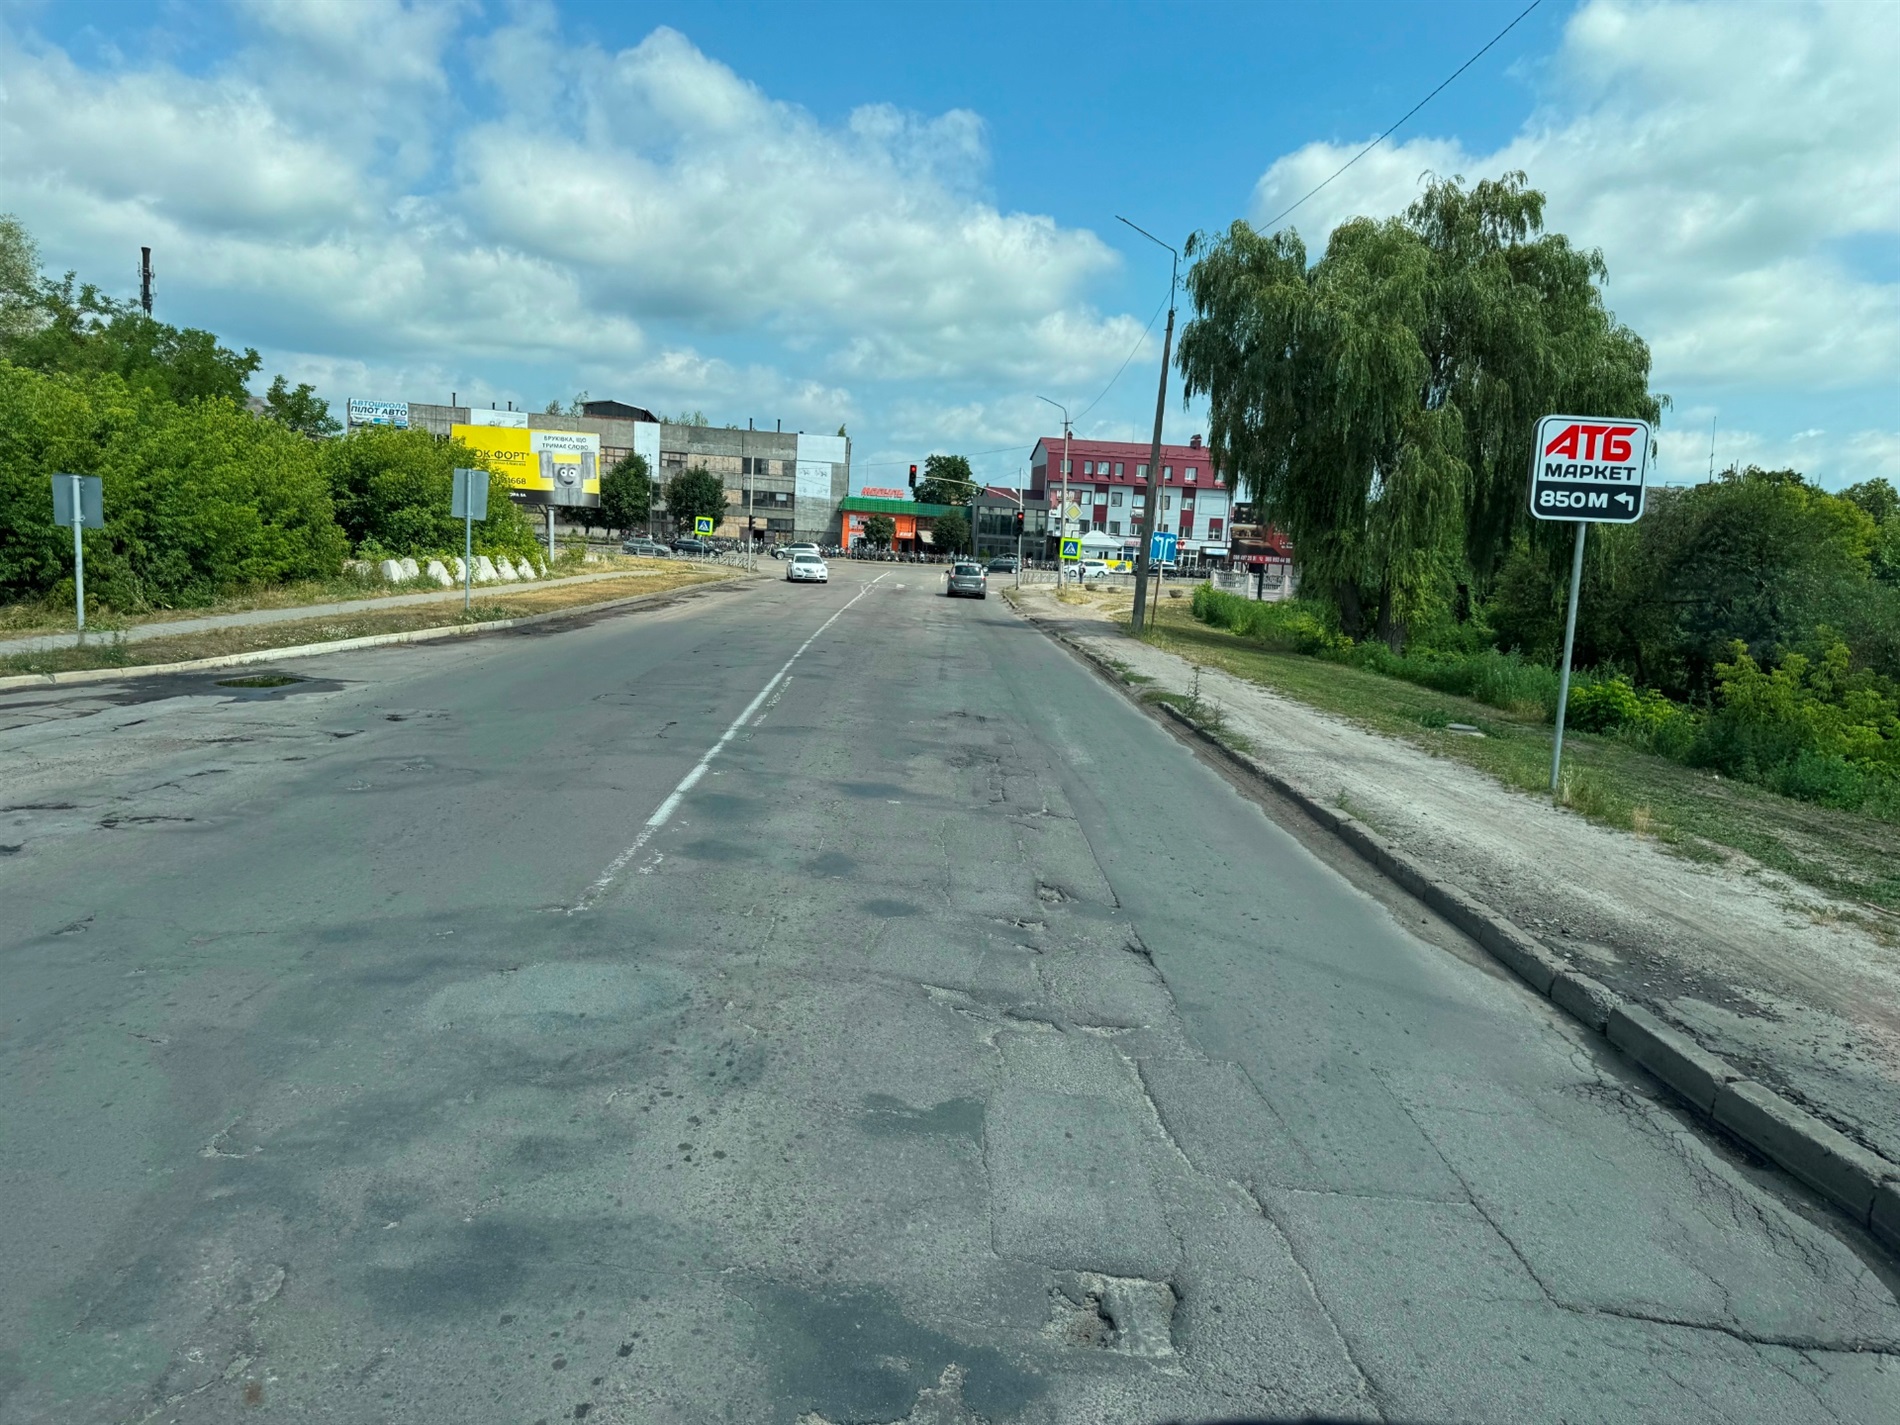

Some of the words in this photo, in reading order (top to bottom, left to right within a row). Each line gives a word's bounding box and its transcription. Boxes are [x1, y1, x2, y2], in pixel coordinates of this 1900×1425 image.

[351, 399, 407, 409] АВТОШКОЛА
[351, 406, 380, 414] ПІЛОТ
[381, 408, 408, 416] АВТО
[1545, 424, 1638, 463] АТБ
[474, 450, 527, 460] ОК-ФОРТ
[1544, 463, 1637, 481] МАРКЕТ
[1539, 489, 1609, 508] 850М
